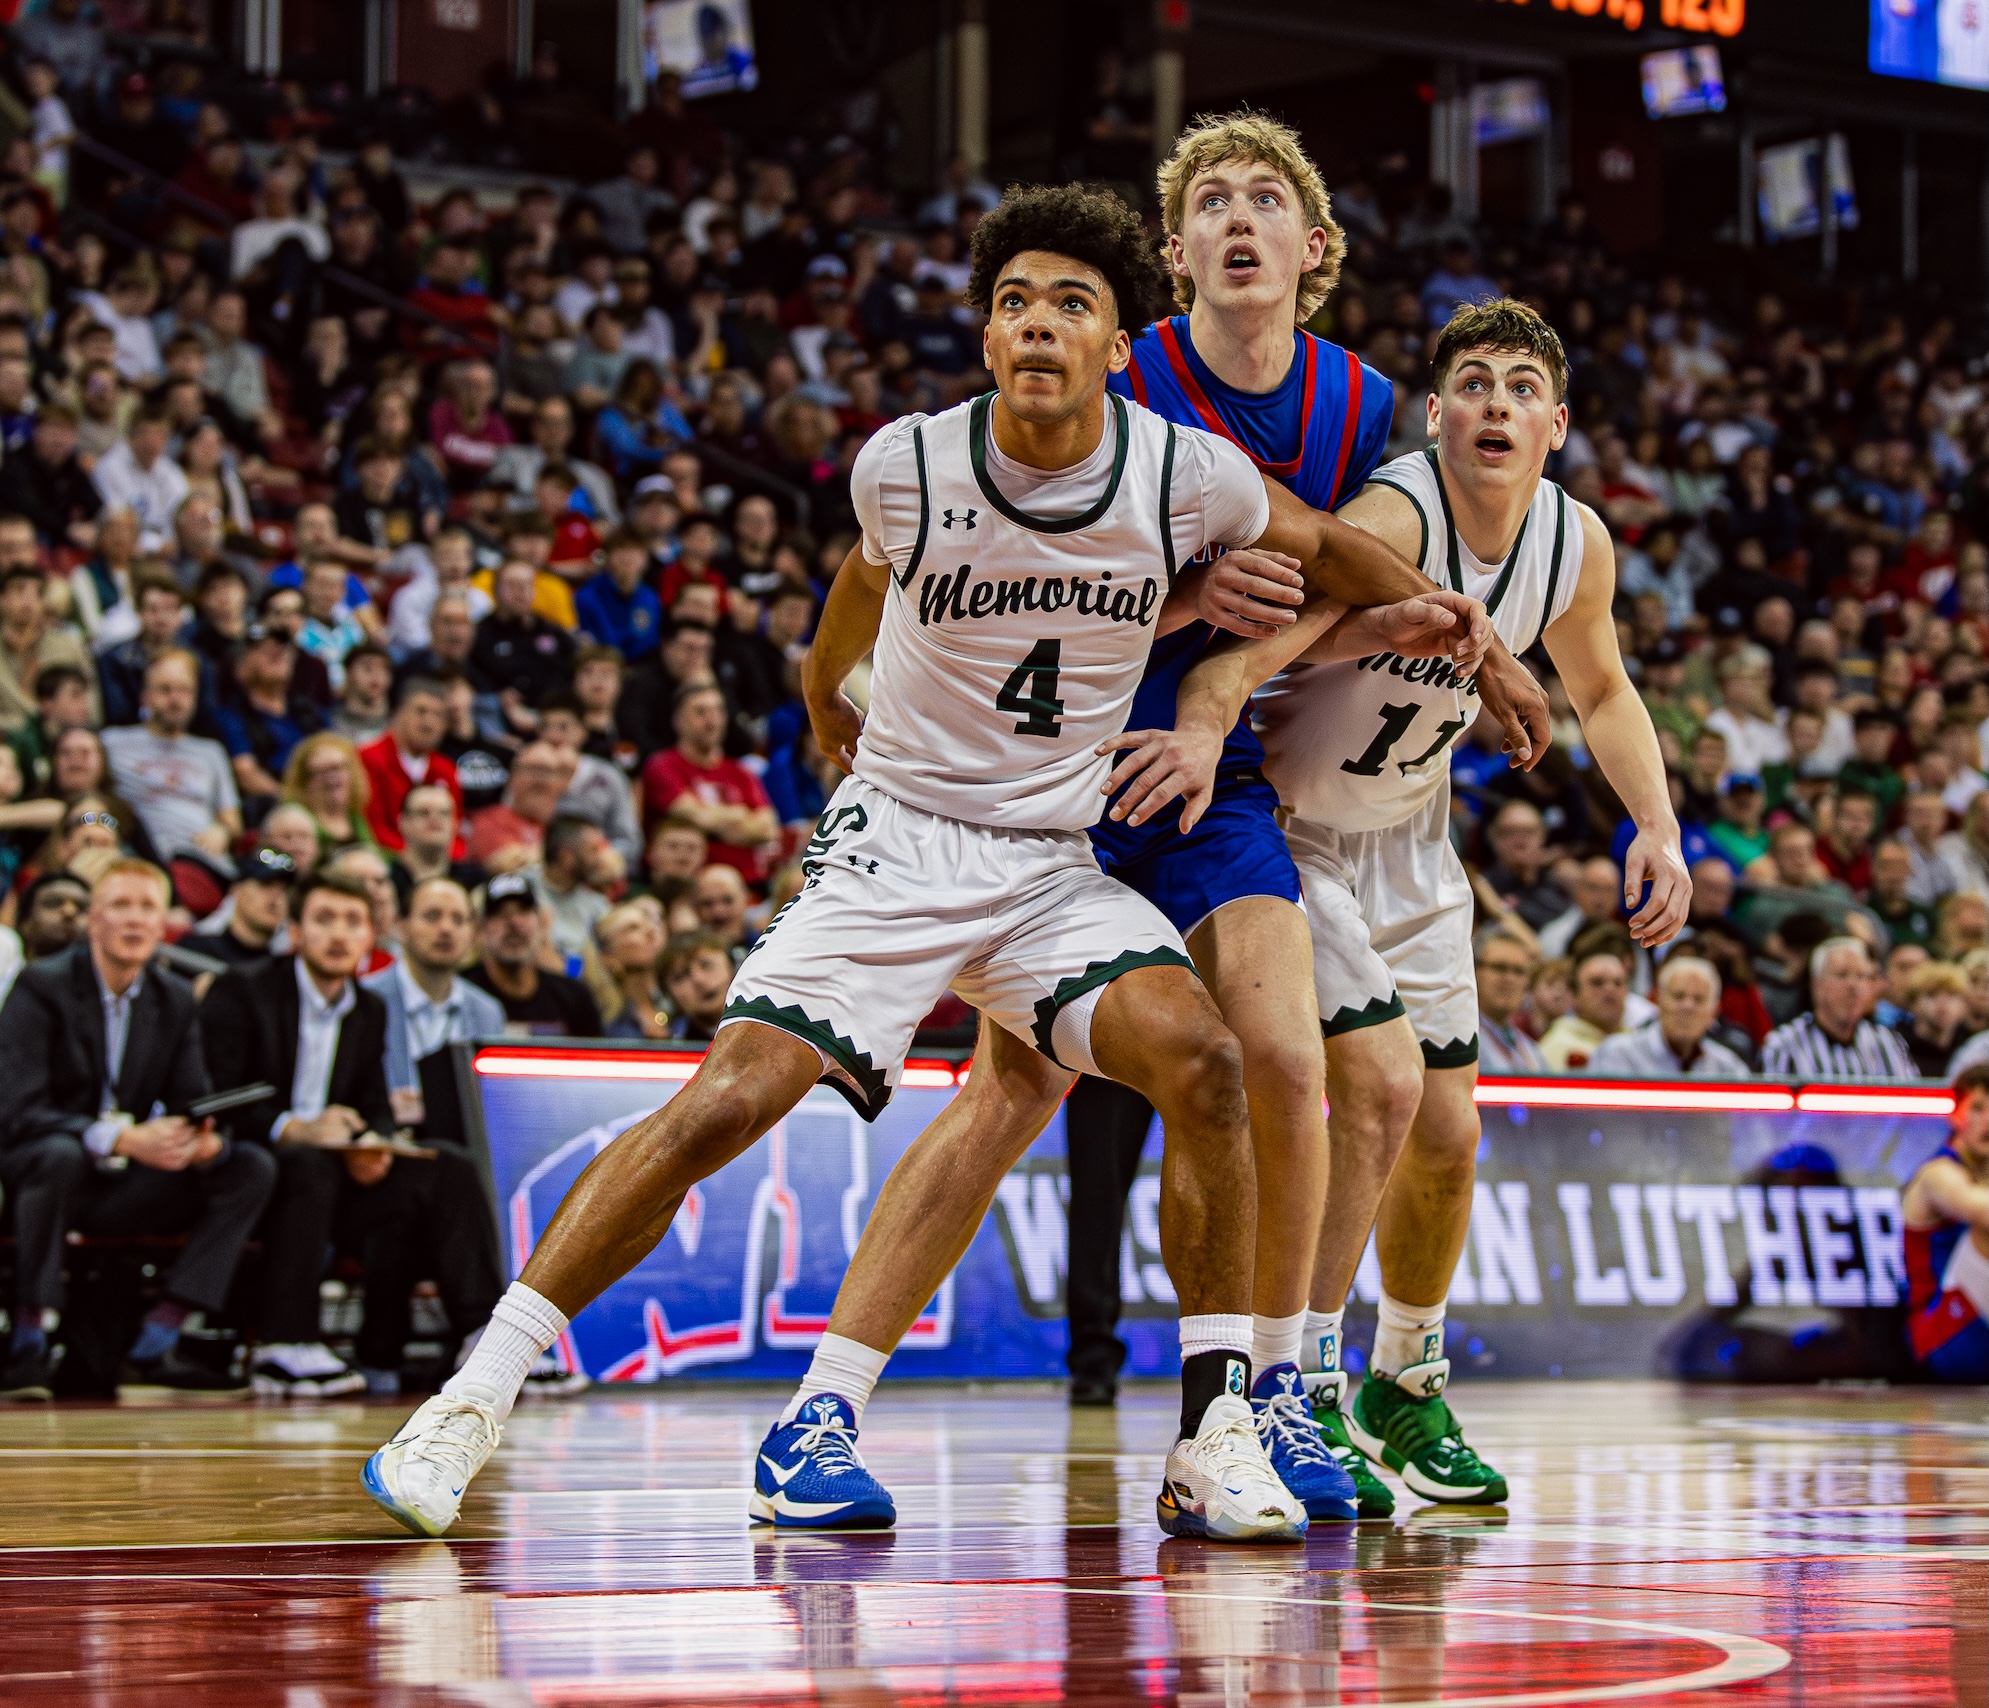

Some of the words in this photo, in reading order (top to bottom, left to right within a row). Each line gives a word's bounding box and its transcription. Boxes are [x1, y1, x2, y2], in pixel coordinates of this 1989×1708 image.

[919, 564, 1157, 627] Memorial
[996, 638, 1065, 738] 4
[1339, 701, 1466, 778] 11
